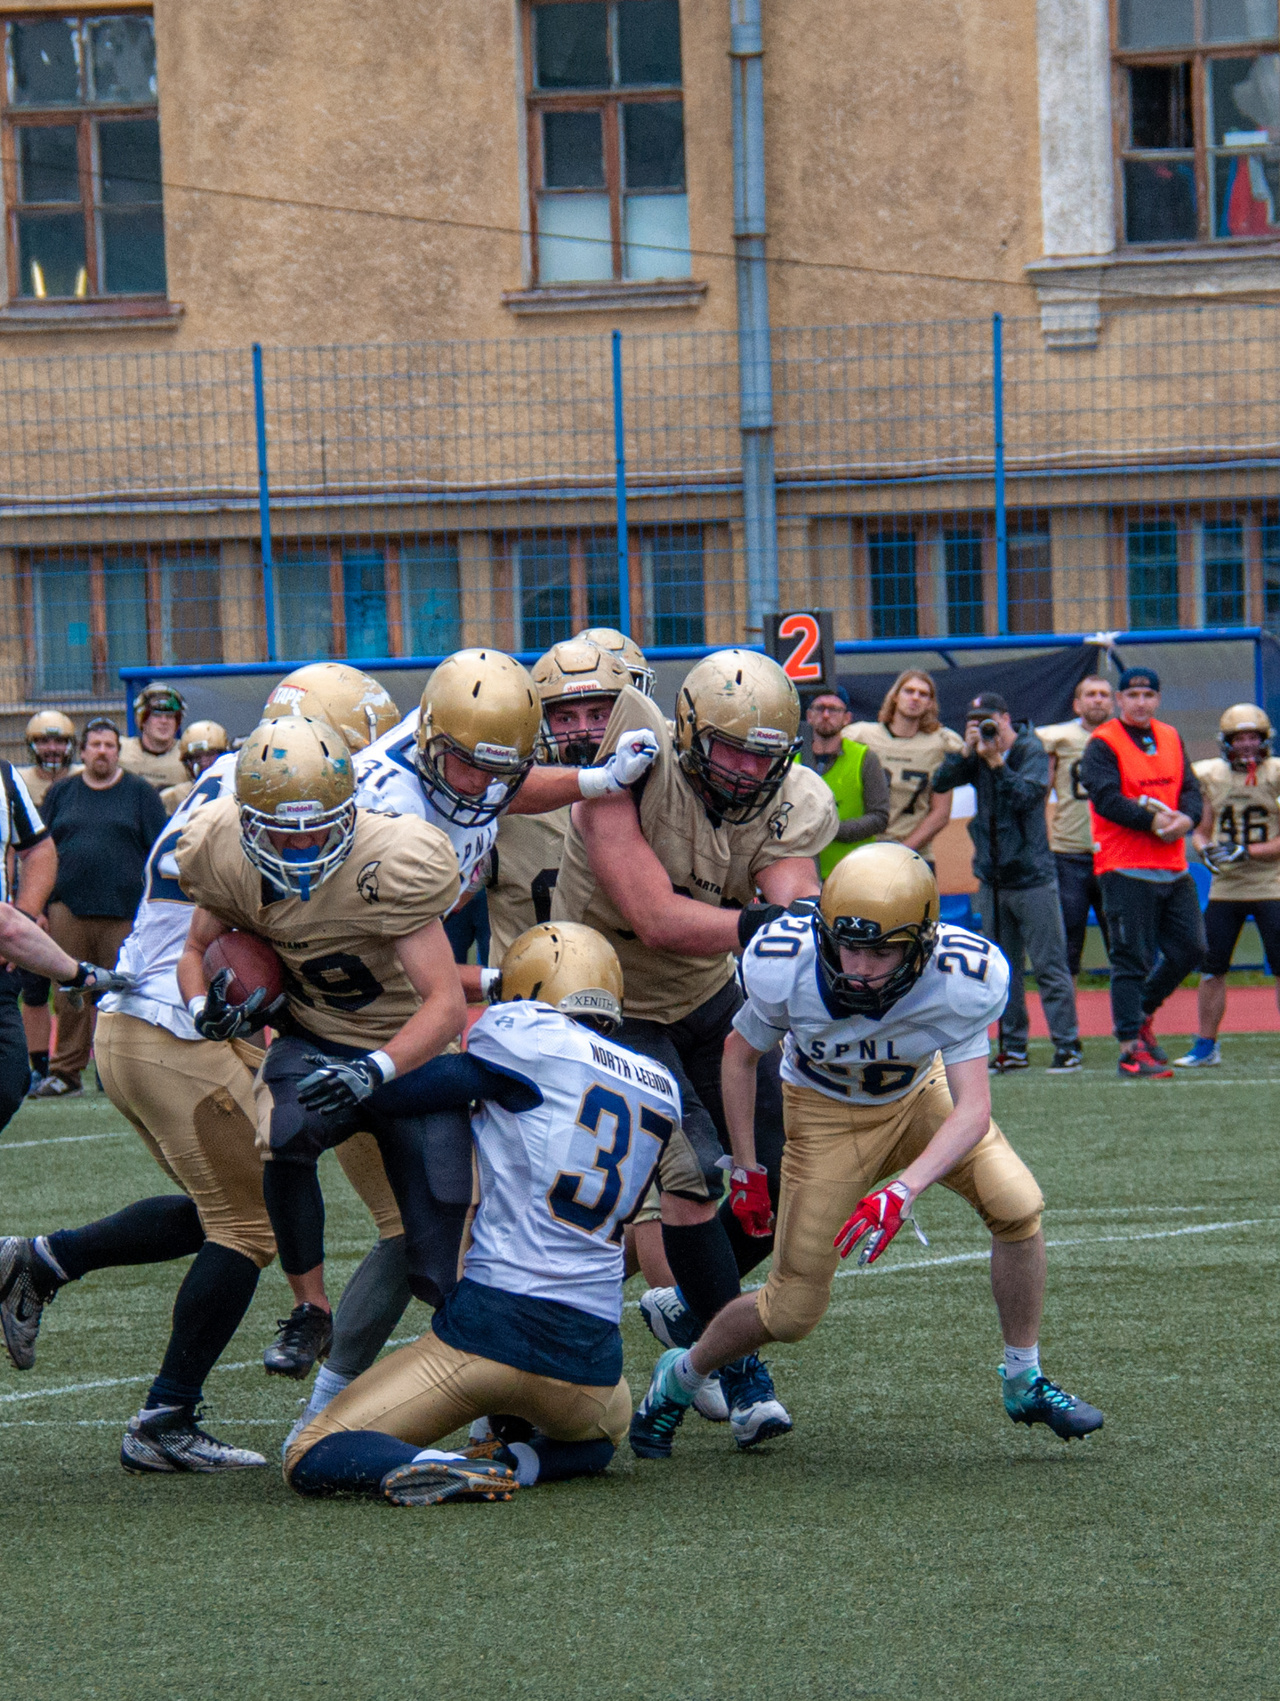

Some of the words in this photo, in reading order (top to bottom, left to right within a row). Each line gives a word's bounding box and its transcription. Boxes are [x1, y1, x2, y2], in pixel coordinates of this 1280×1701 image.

[779, 613, 821, 681] 2
[286, 804, 313, 813] Riddell
[1220, 804, 1269, 844] 46
[937, 934, 991, 983] 20
[575, 995, 614, 1010] XENITH
[589, 1041, 631, 1079] NORTH
[632, 1063, 674, 1098] LEGION
[811, 1040, 900, 1060] SPNL
[545, 1081, 674, 1246] 37
